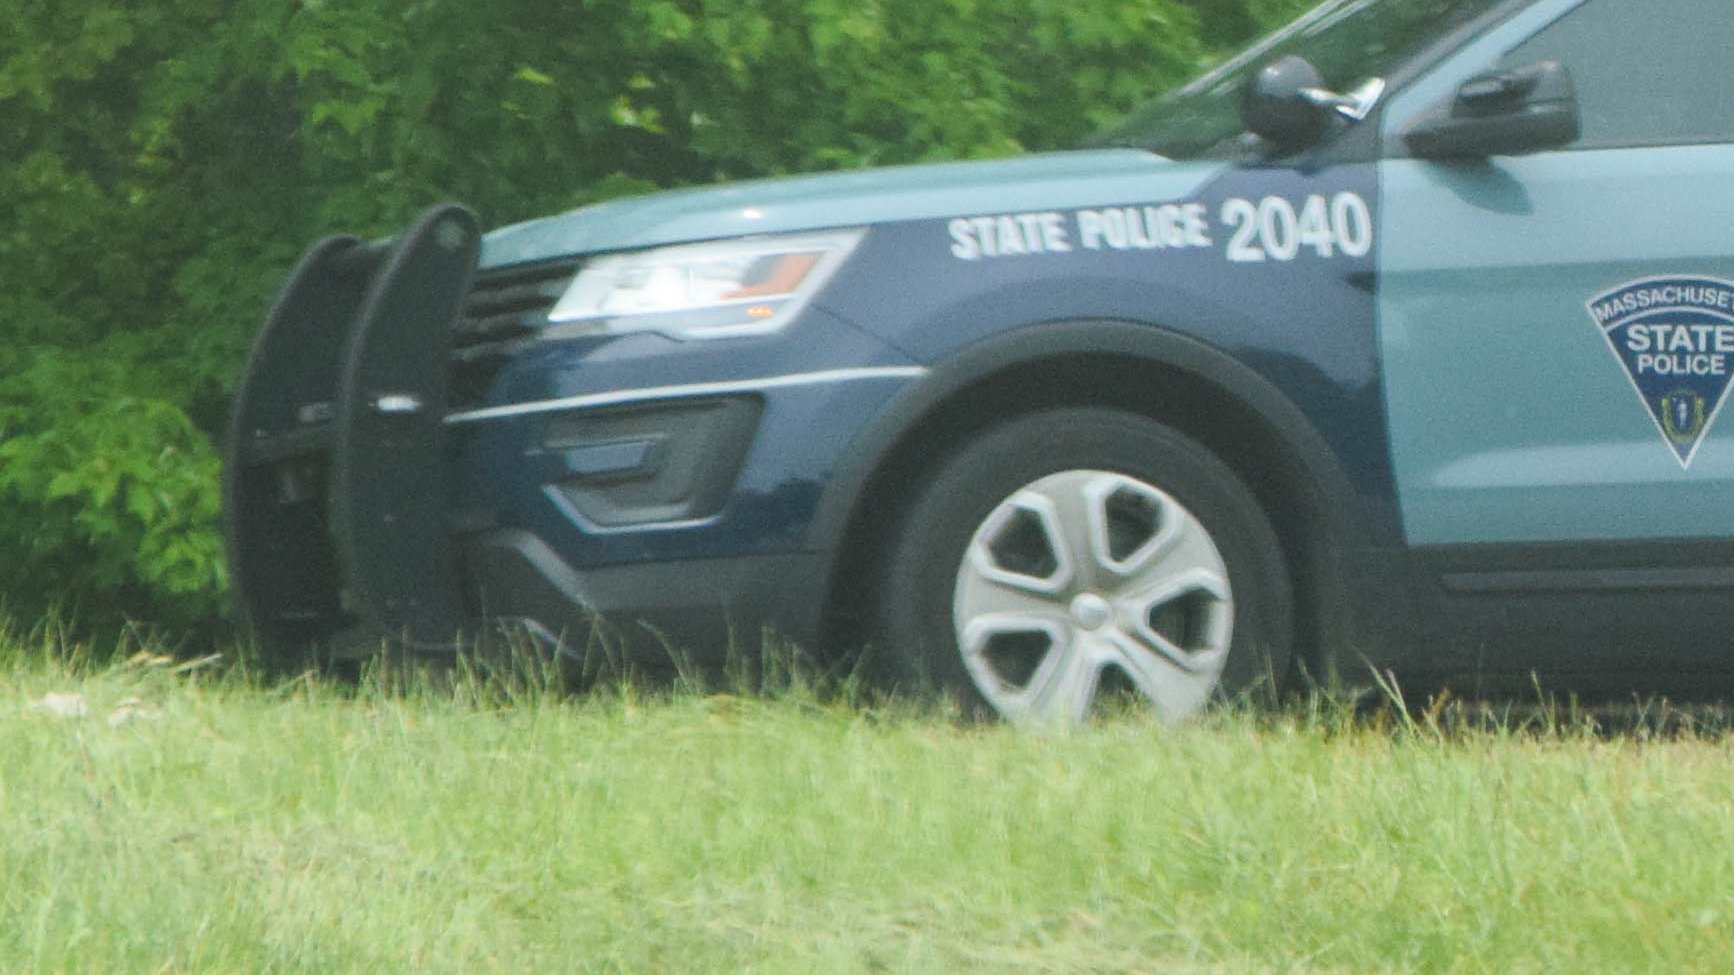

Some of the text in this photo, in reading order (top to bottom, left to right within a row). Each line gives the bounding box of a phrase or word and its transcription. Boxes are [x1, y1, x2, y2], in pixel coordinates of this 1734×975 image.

[948, 192, 1371, 261] STATE POLICE 2040
[1638, 354, 1725, 375] POLICE
